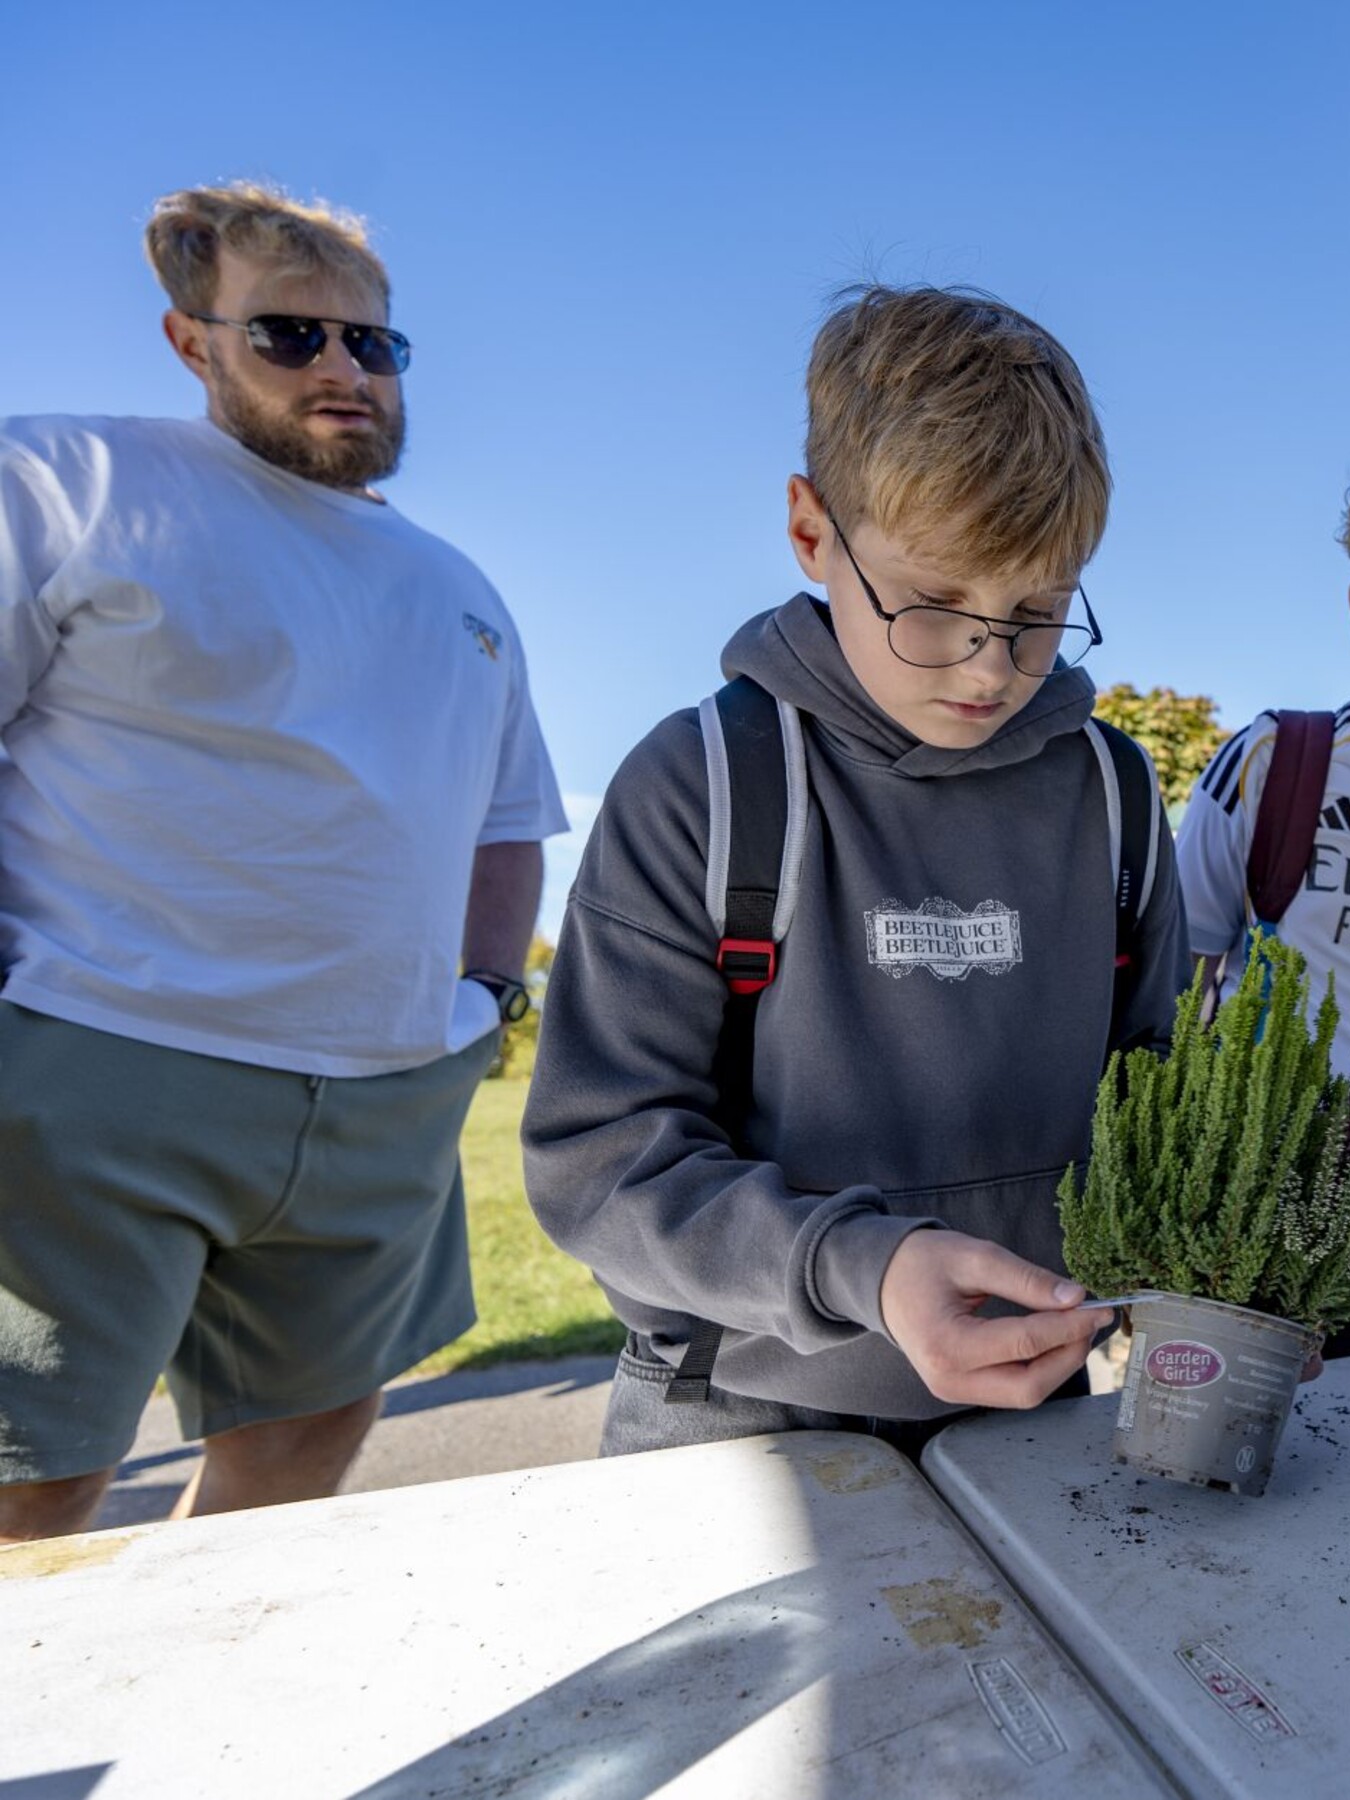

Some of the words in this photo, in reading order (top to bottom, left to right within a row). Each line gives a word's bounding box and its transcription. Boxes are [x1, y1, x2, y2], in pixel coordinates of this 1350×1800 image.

[884, 920, 1004, 940] BEETLEJUICE
[885, 938, 1005, 958] BEETLEJUICE
[1155, 1350, 1211, 1367] Garden
[1163, 1366, 1201, 1382] Girls
